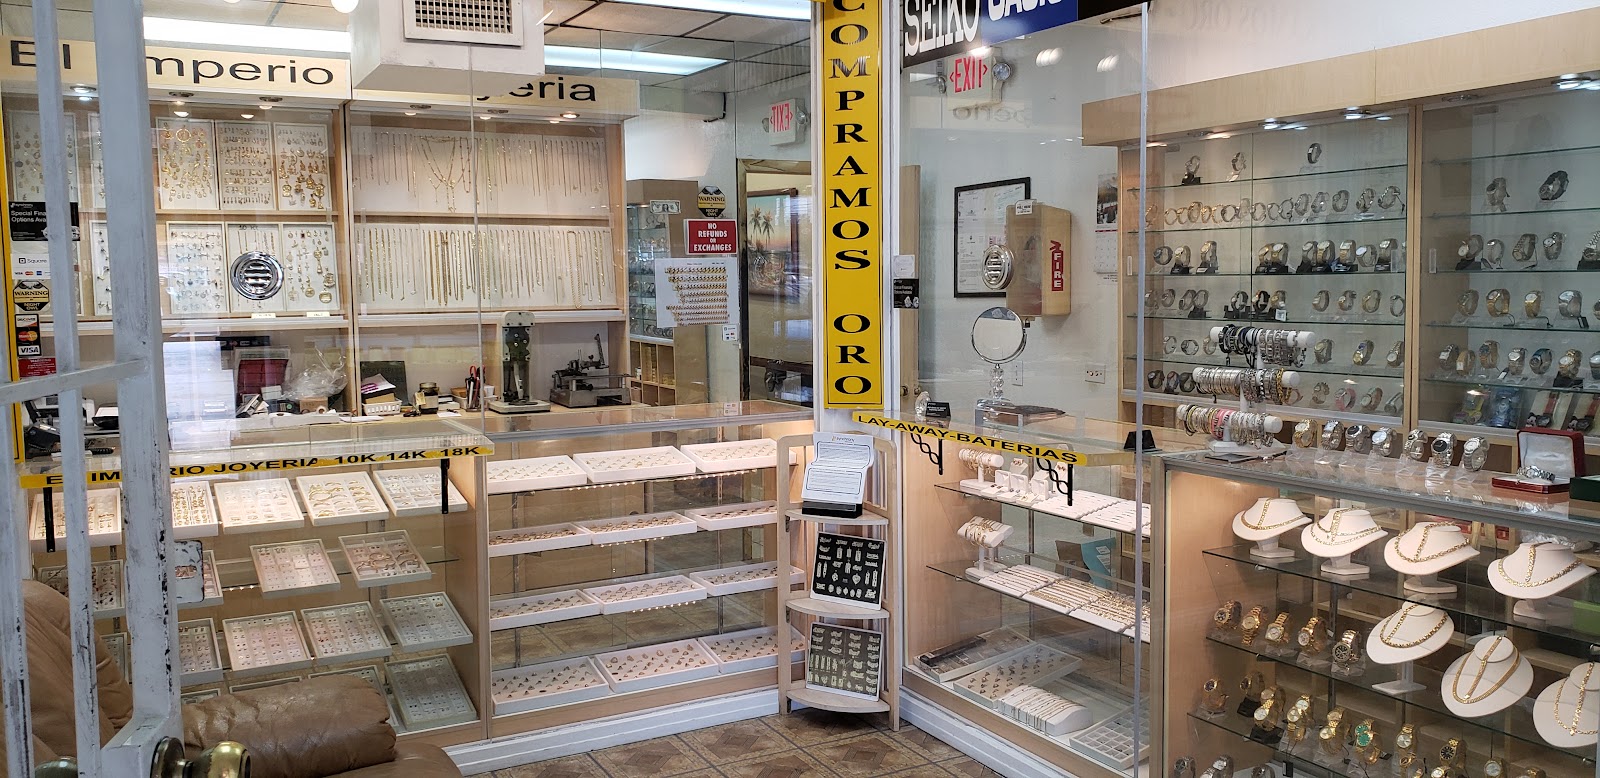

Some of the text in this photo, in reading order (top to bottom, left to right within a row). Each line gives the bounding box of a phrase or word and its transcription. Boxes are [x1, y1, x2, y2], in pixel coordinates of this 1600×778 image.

[904, 0, 981, 57] SEIKO
[146, 56, 334, 85] mperio
[828, 0, 872, 270] COMPRAMOS
[1054, 252, 1062, 288] FIRE
[833, 314, 872, 395] ORO
[92, 465, 205, 482] IMRIO
[214, 458, 318, 473] JOYERIA
[335, 454, 376, 464] 10K
[387, 450, 427, 460] 14K
[440, 446, 480, 456] 18K
[858, 415, 1078, 464] LAY-AWAY-BATERIAS
